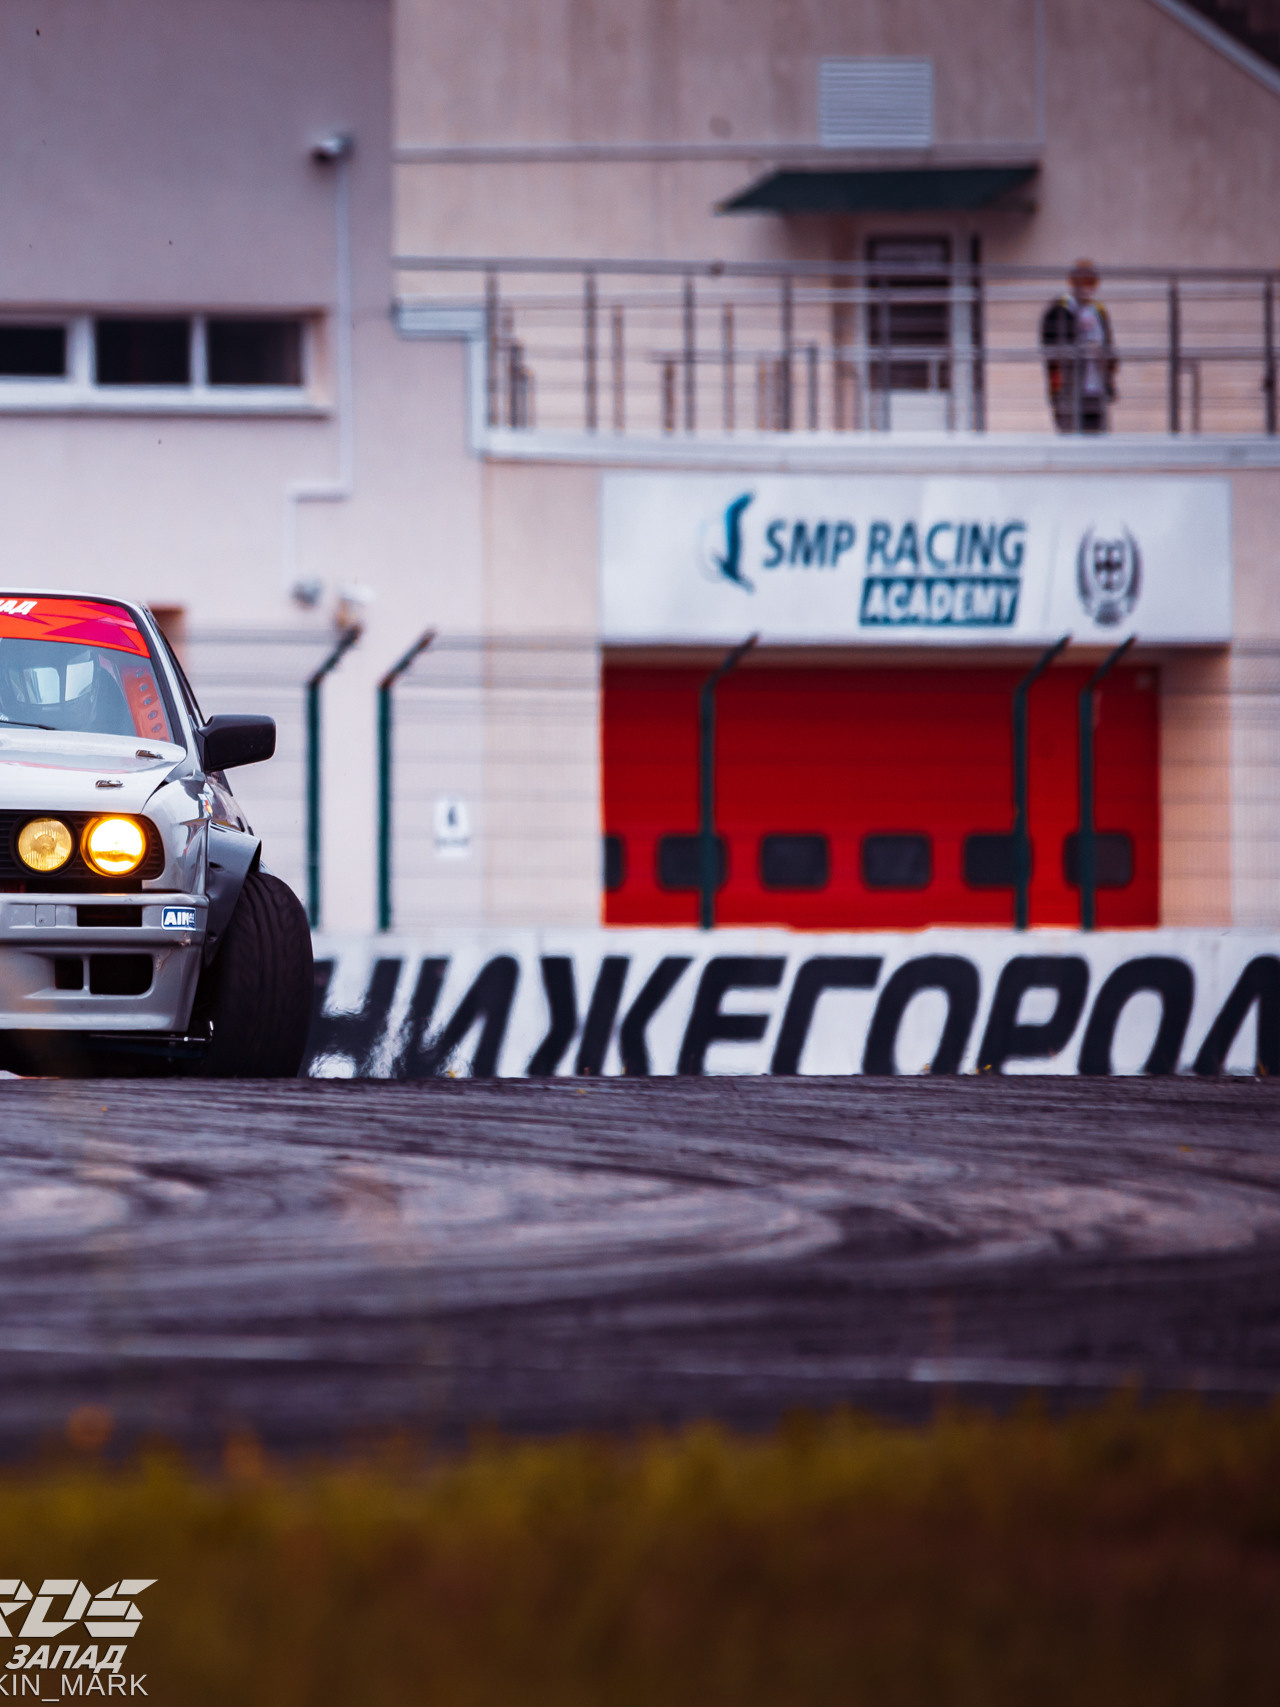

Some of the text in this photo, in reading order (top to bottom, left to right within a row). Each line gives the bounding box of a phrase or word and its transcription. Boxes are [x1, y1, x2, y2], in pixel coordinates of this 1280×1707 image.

[763, 521, 1026, 569] SMP RACING
[865, 581, 1017, 618] ACADEMY
